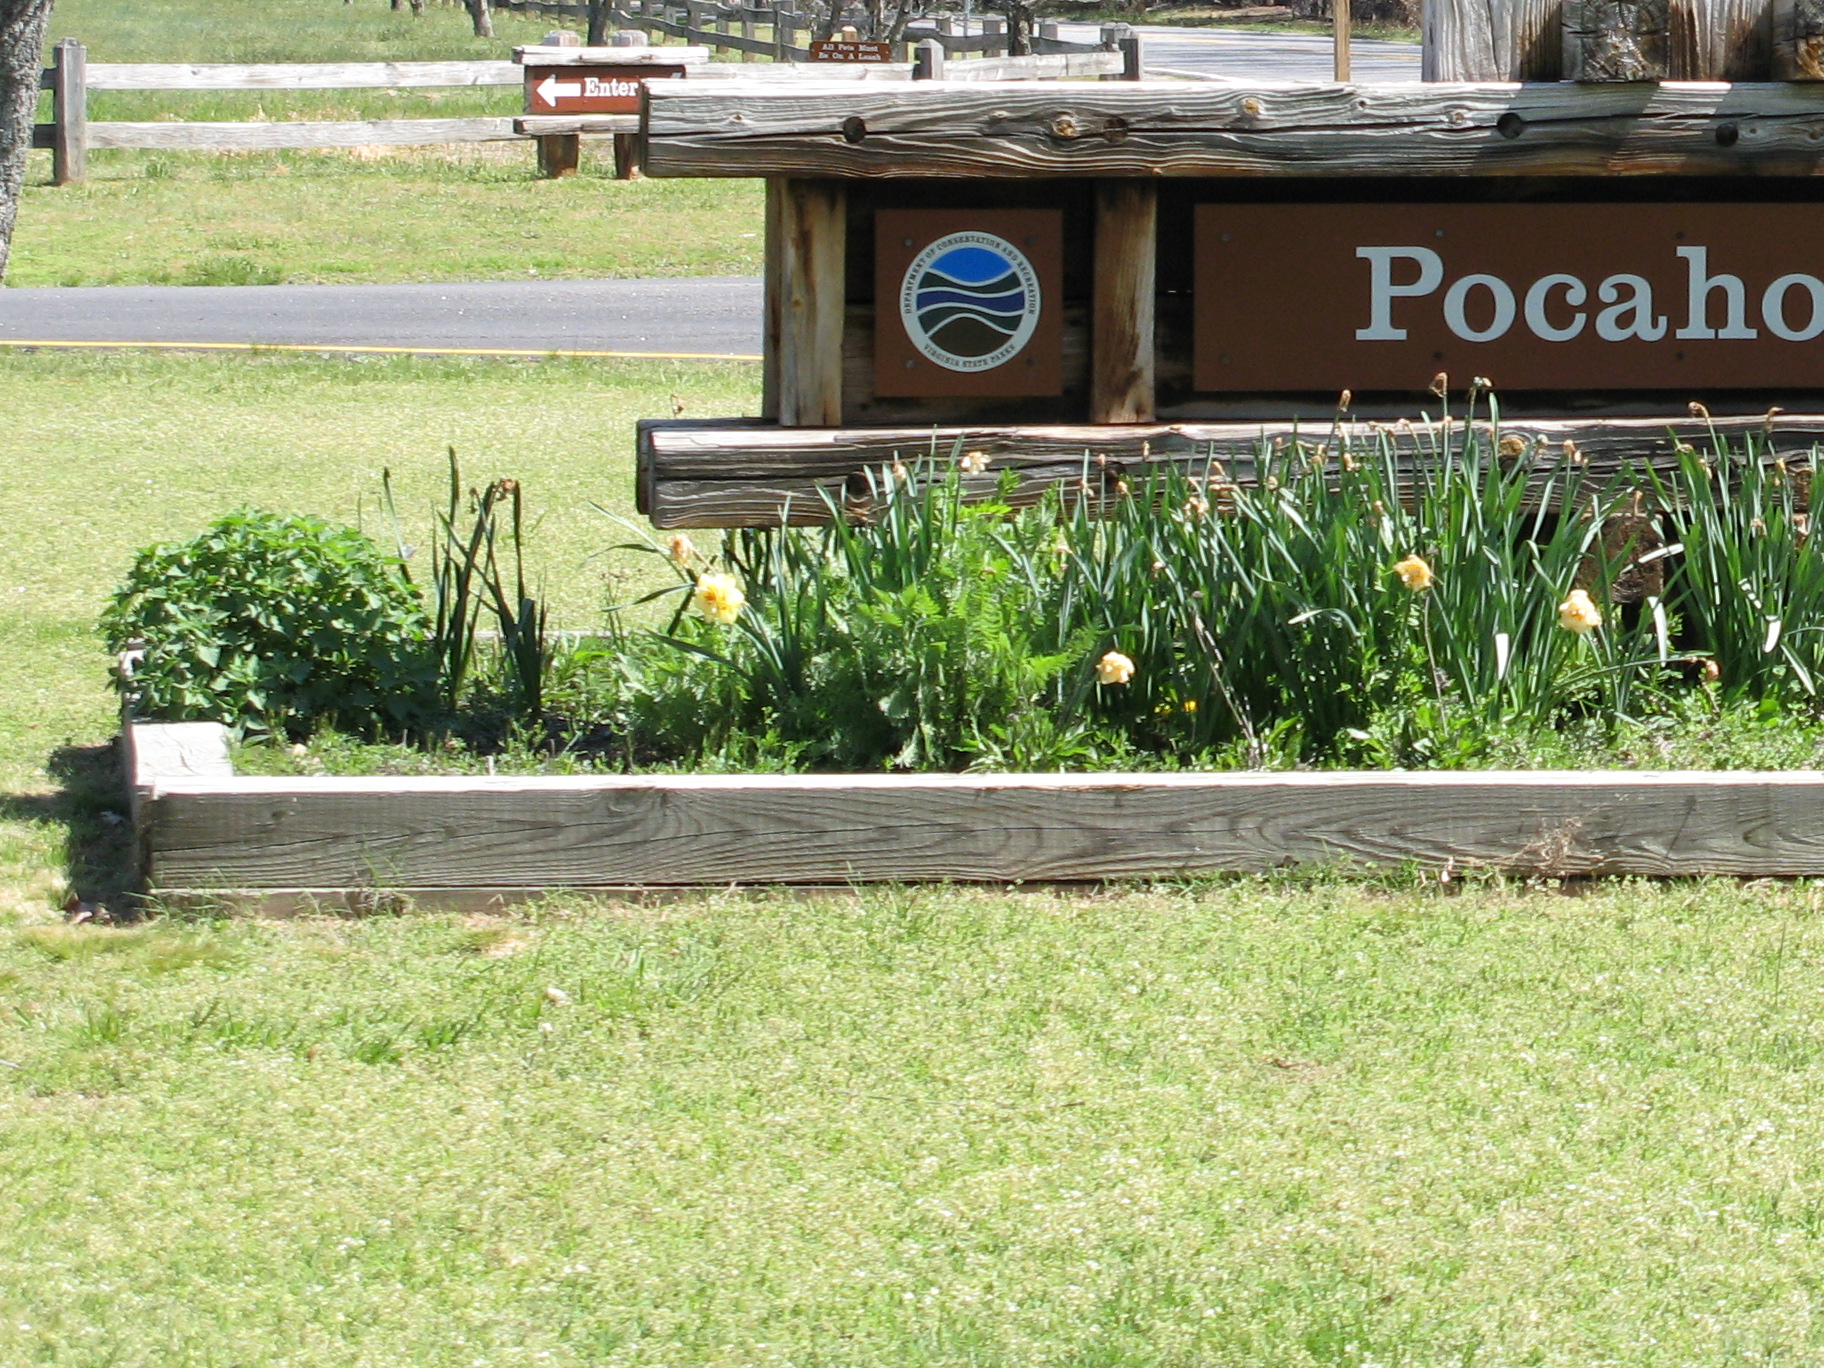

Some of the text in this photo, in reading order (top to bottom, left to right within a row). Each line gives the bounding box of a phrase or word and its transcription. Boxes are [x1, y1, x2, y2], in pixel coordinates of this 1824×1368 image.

[583, 77, 639, 97] Enter
[905, 235, 1036, 315] DEPARTMENT OF CONSERVATION AND RECREATION
[924, 343, 1016, 368] VIRGINIA STATE PARKS
